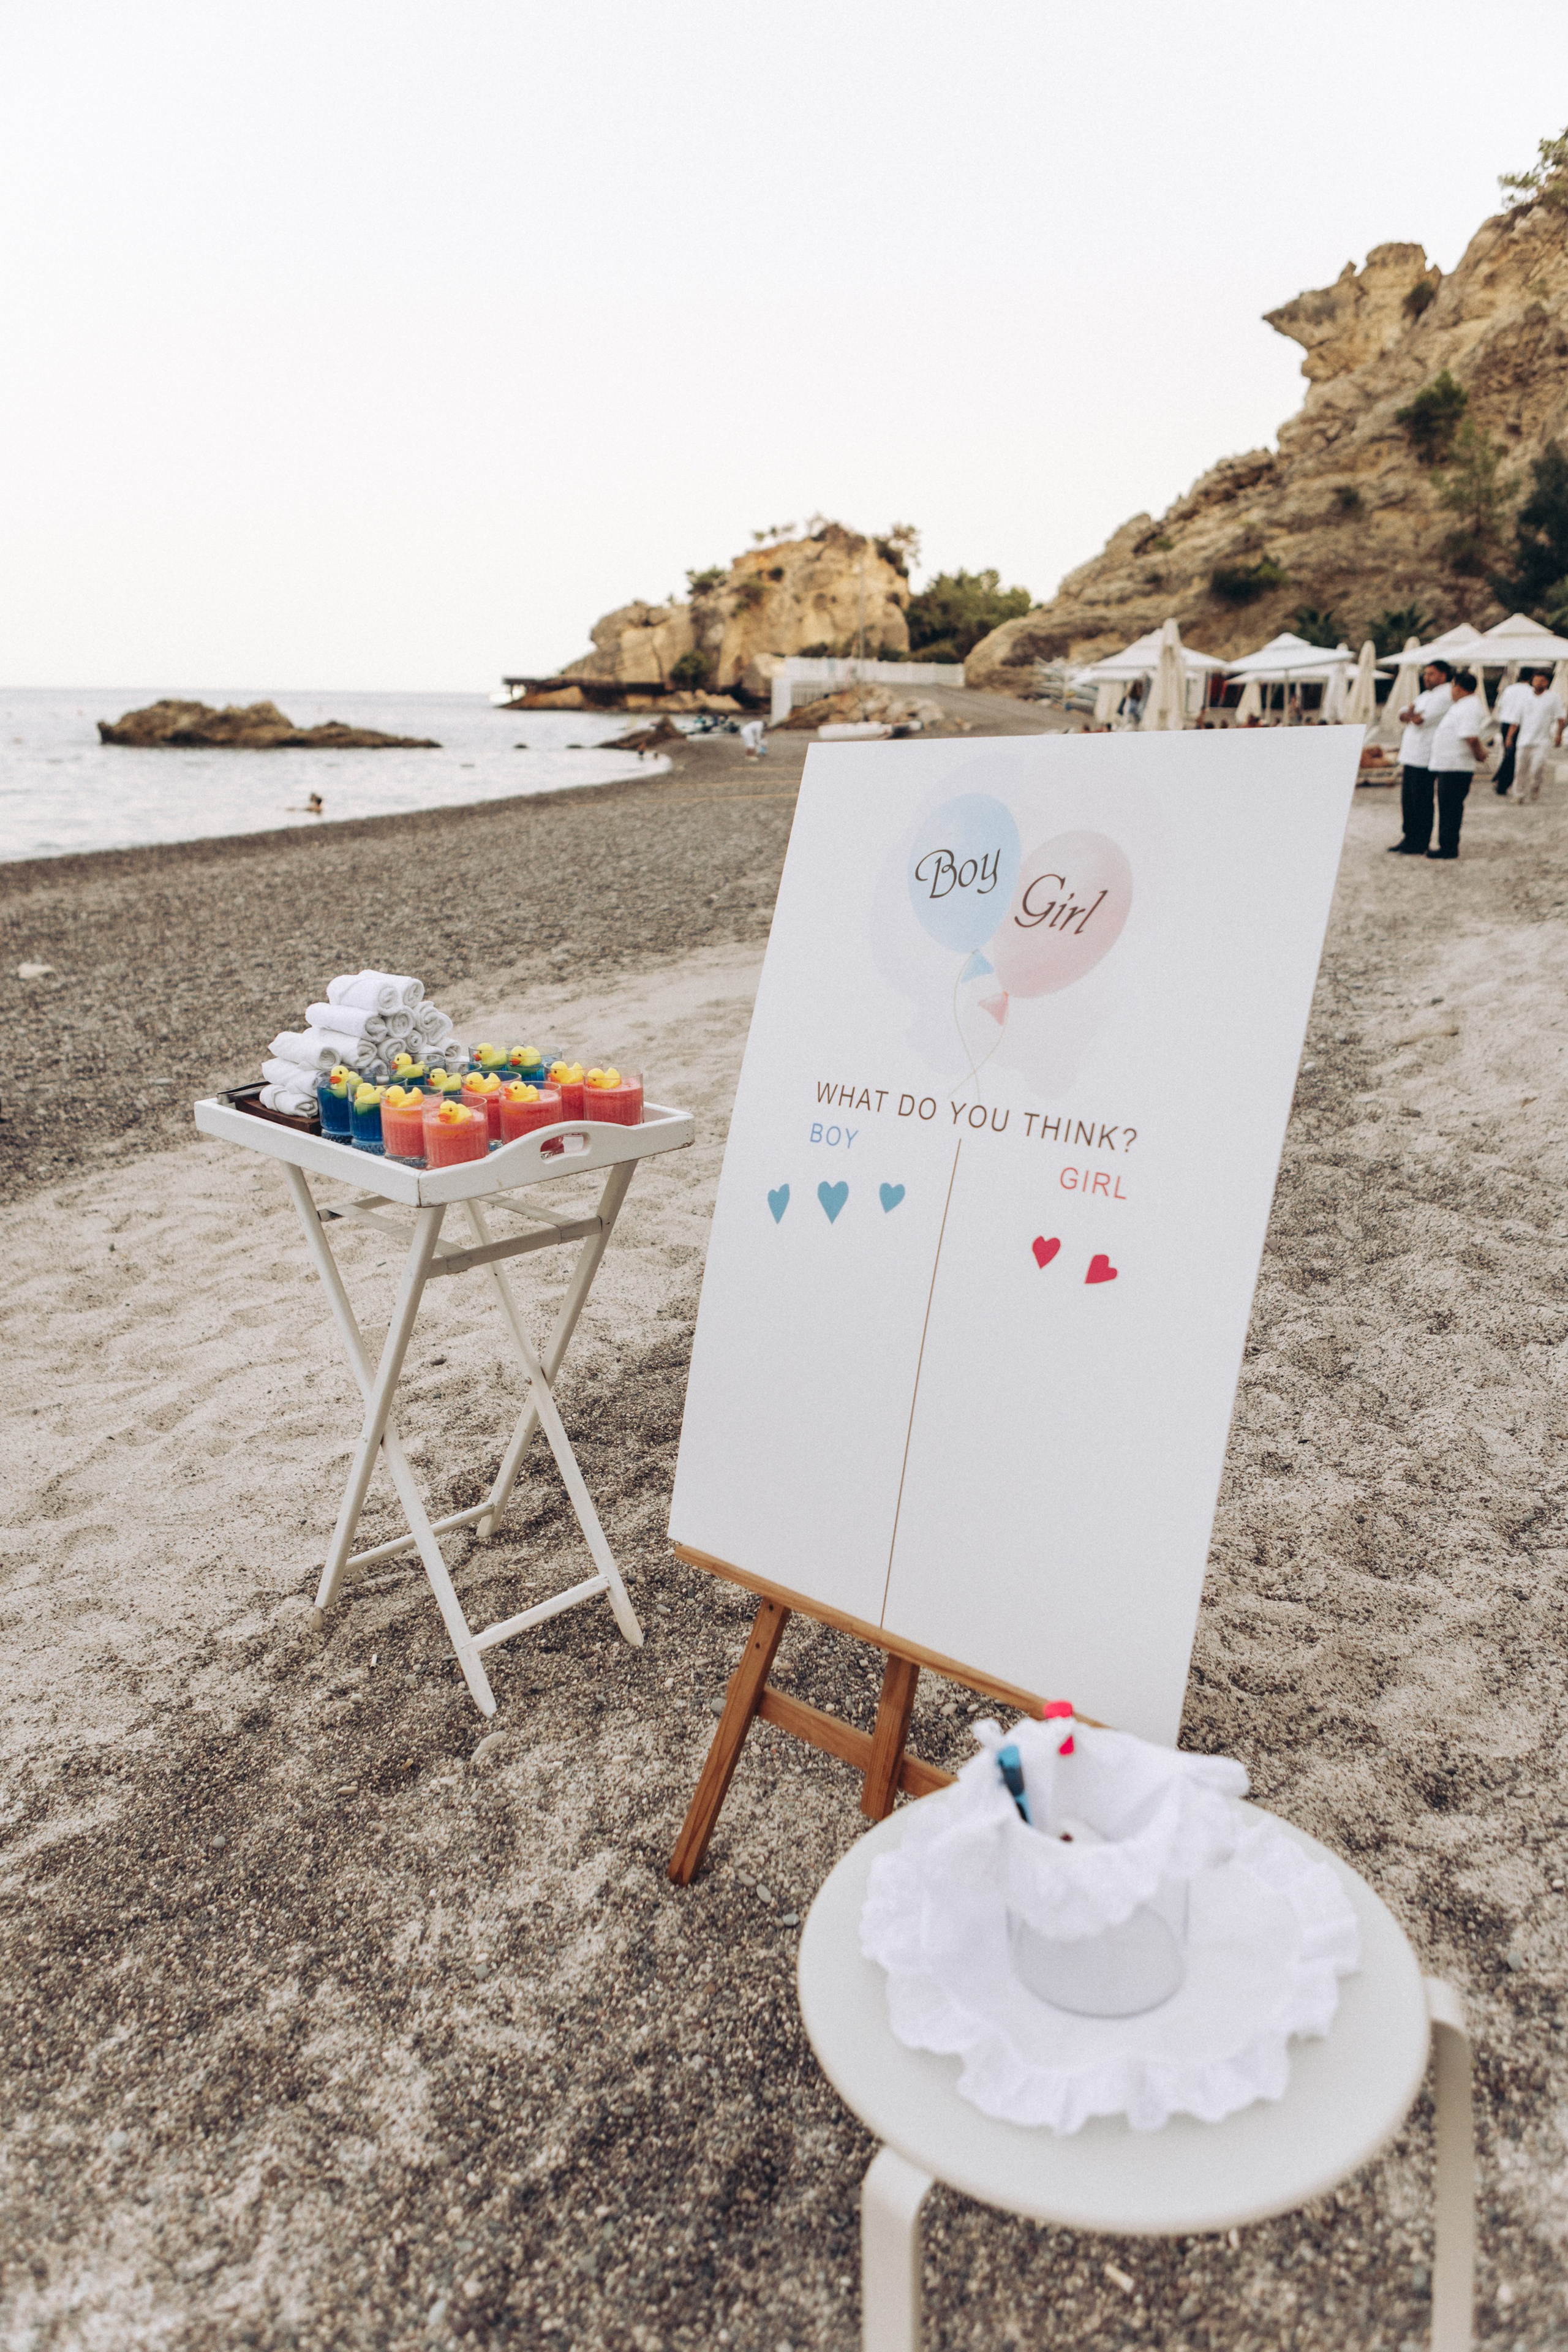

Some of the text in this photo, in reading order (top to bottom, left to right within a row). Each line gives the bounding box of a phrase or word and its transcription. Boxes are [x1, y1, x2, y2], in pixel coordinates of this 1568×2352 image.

[915, 848, 1001, 899] Boy
[1014, 874, 1108, 935] Girl
[810, 1123, 858, 1148] BOY
[818, 1081, 1137, 1153] WHAT DO YOU THINK?
[1060, 1167, 1126, 1200] GIRL
